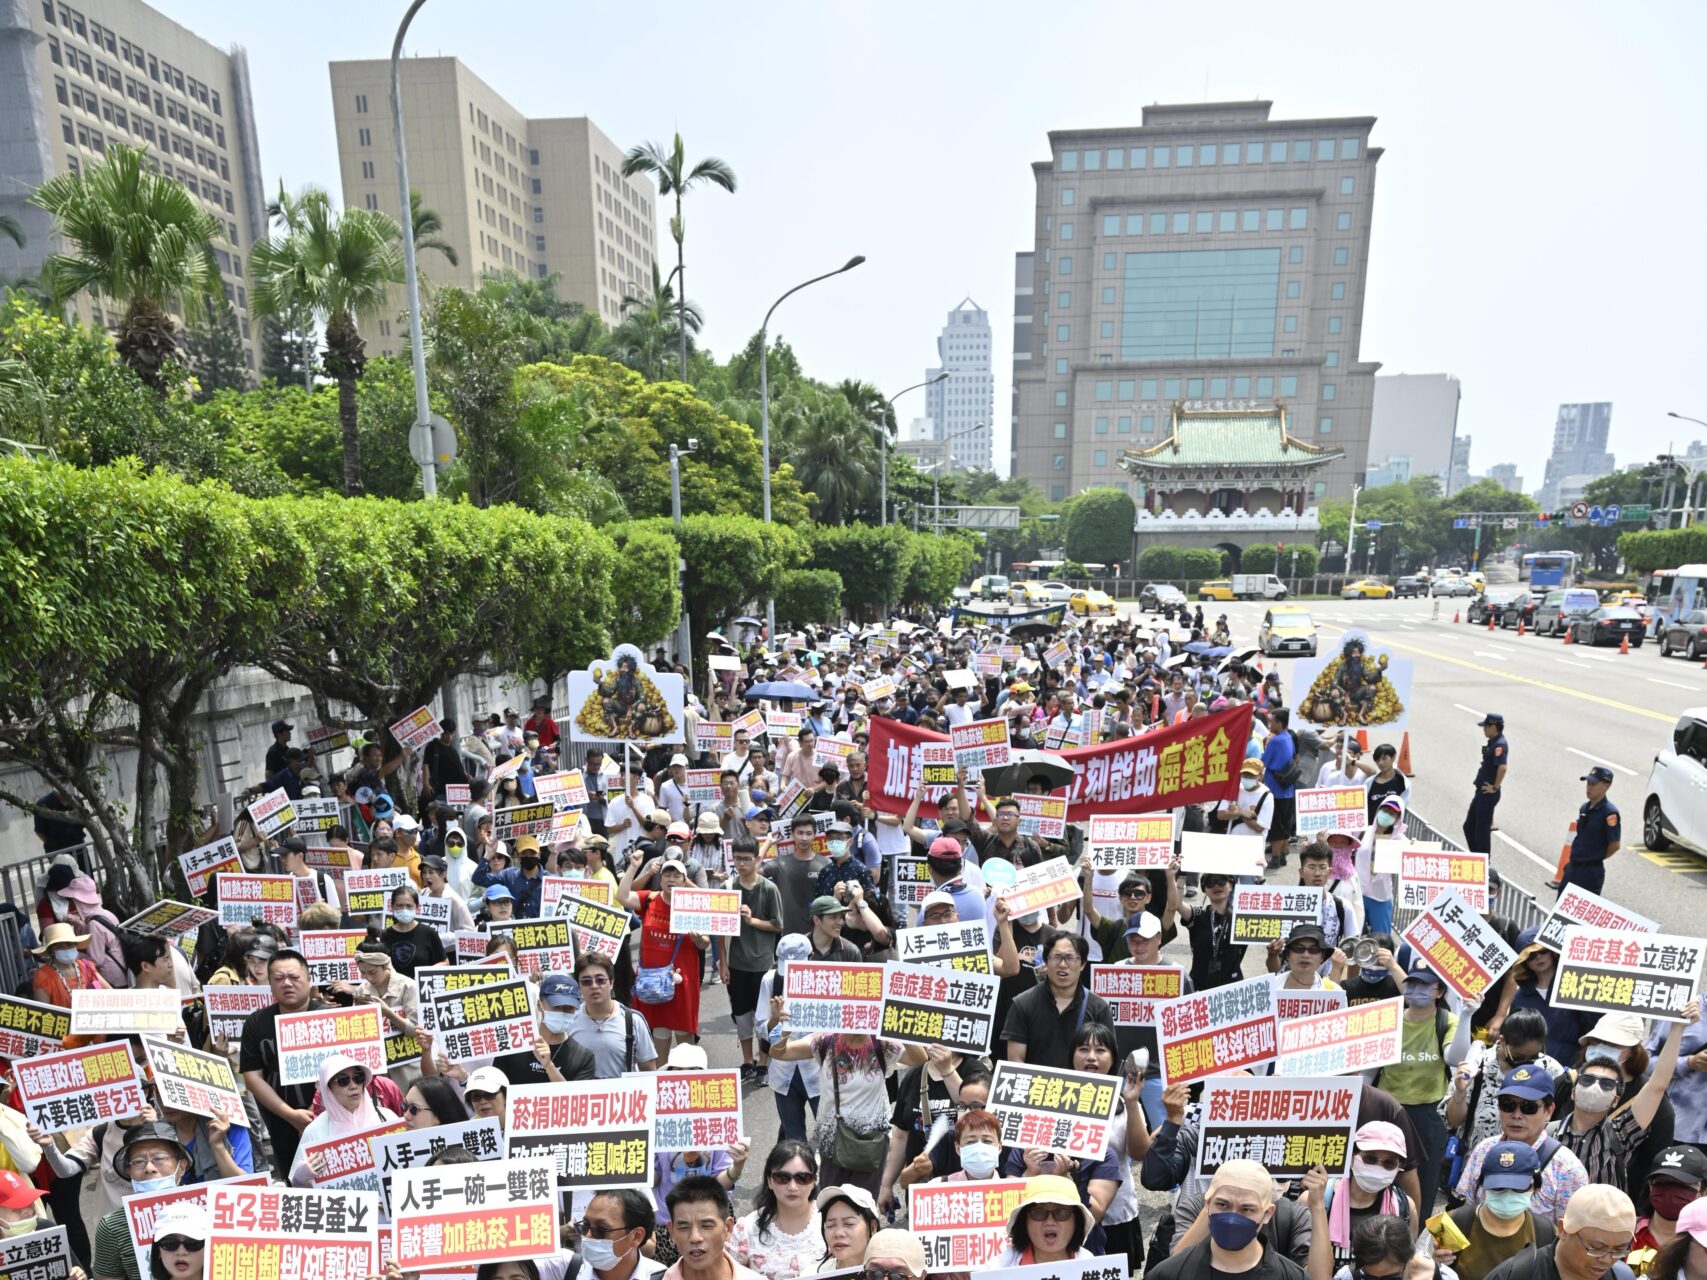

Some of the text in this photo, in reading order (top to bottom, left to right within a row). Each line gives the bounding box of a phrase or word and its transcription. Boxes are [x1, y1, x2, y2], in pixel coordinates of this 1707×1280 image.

[953, 723, 1007, 747] 加熱菸稅助癌藥
[1299, 790, 1364, 810] 加熱菸稅助癌藥
[1093, 846, 1170, 866] 不要有錢當乞丐
[221, 880, 293, 900] 加熱菸稅助癌藥
[348, 873, 406, 888] 癌症基金立意好
[558, 899, 626, 937] 不要有錢不會用
[1238, 892, 1317, 912] 癌症基金立意好
[903, 927, 985, 954] 人手一碗一雙筷
[1433, 897, 1509, 974] 人手一碗一雙筷
[1568, 936, 1697, 974] 癌症基金立意好
[1410, 918, 1487, 994] 敲響加熱菸上路
[788, 970, 881, 998] 加熱菸稅助癌藥
[888, 971, 994, 1009] 癌症基金立意好
[437, 987, 528, 1028] 不要有錢不會用
[789, 1003, 881, 1030] 總統總統我愛您
[883, 1006, 989, 1046] 執行沒錢耍白爛
[281, 1012, 379, 1048] 加熱菸稅助癌藥
[445, 1020, 534, 1059] 想當菩薩變乞丐
[1283, 1008, 1397, 1048] 加熱菸稅助癌藥
[151, 1046, 235, 1091] 不要有錢不會用
[1166, 1021, 1276, 1078] 加熱菸稅助癌藥
[1282, 1036, 1395, 1076] 總統總統我愛您
[20, 1050, 132, 1099] 敲醒政府睜開眼
[33, 1084, 141, 1130] 不要有錢當乞丐
[513, 1090, 647, 1132] 菸捐明明可以收
[656, 1081, 737, 1110] 菸稅助癌藥
[996, 1072, 1114, 1118] 不要有錢不會用
[1209, 1089, 1353, 1121] 菸捐明明可以收
[400, 1168, 550, 1212] 人手一碗一雙筷
[213, 1192, 369, 1234] 不要有錢當乞丐
[915, 1187, 1030, 1237] 加熱菸捐在哪
[399, 1213, 552, 1260] 敲響加熱菸上路
